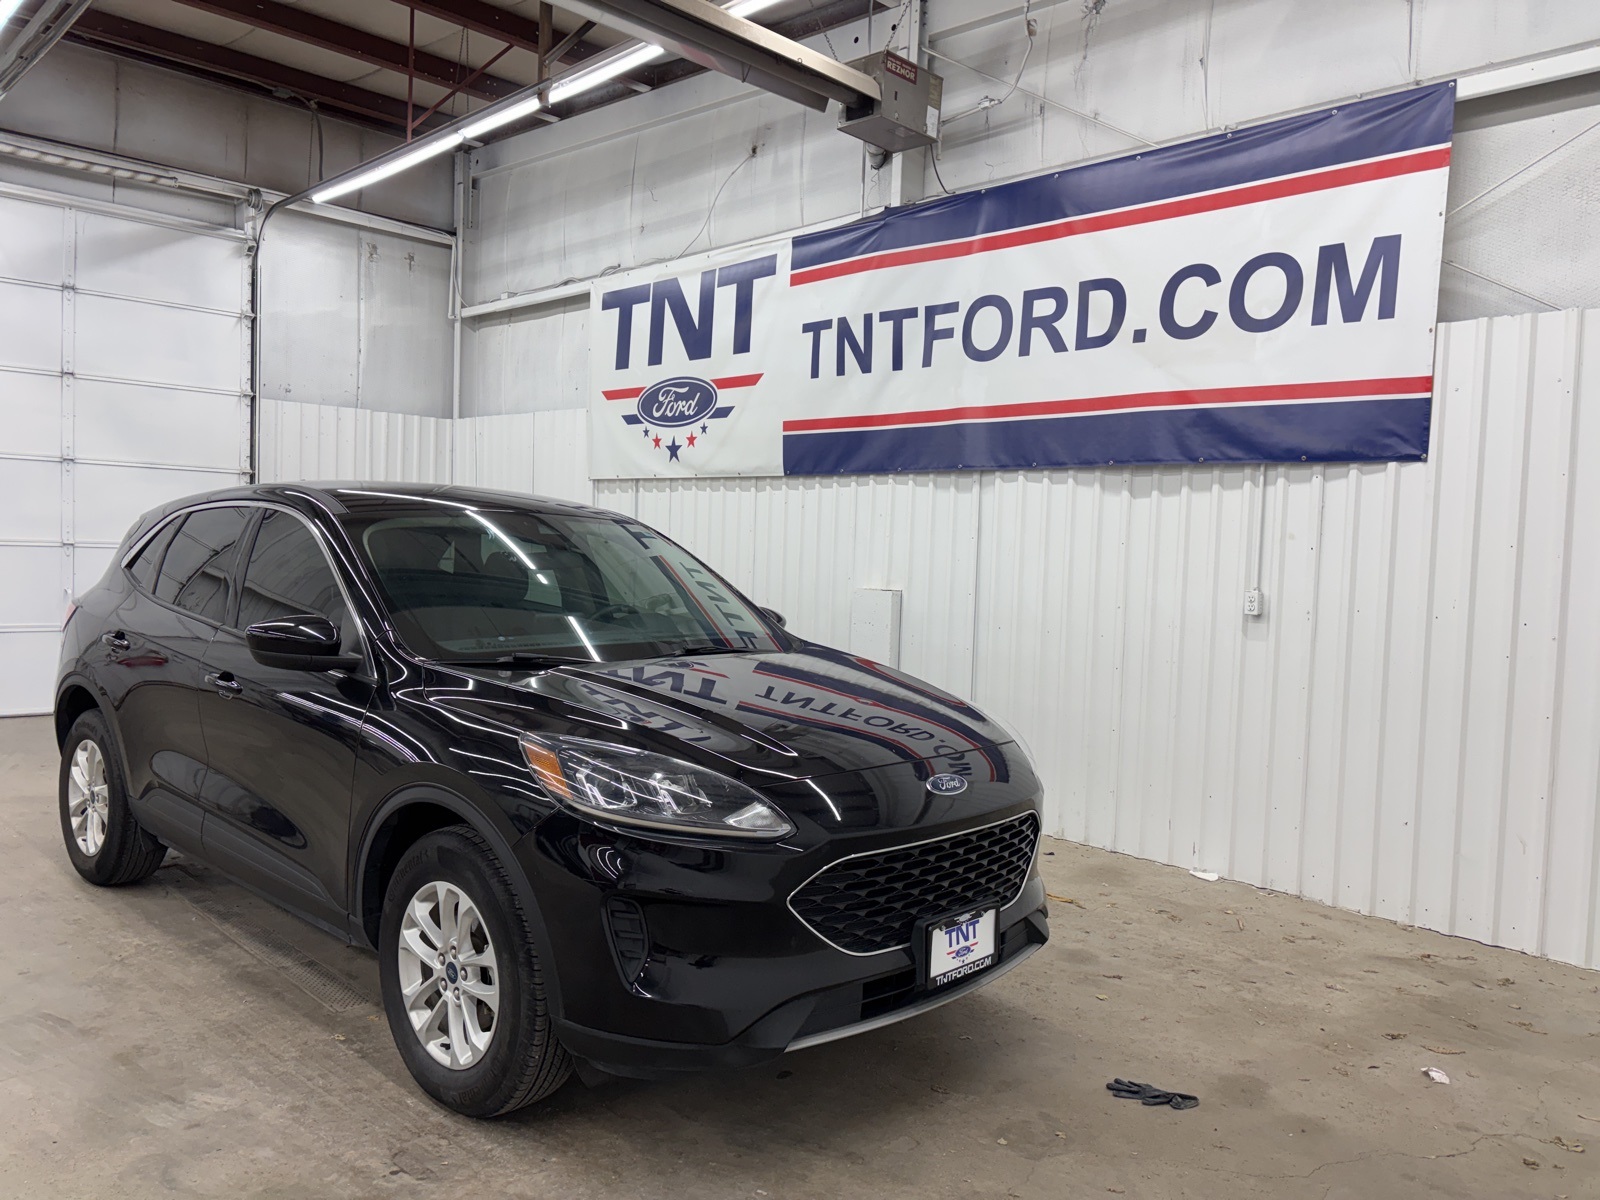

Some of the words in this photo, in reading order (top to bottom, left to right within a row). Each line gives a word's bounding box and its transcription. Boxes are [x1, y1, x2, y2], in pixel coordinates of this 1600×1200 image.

[886, 60, 916, 81] REZNOR
[602, 253, 777, 371] TNT
[801, 234, 1402, 380] TNTFORD.COM
[652, 386, 700, 418] Ford
[937, 776, 961, 791] Ford
[945, 919, 980, 948] TNT
[936, 956, 992, 986] TNTFORD.COM
